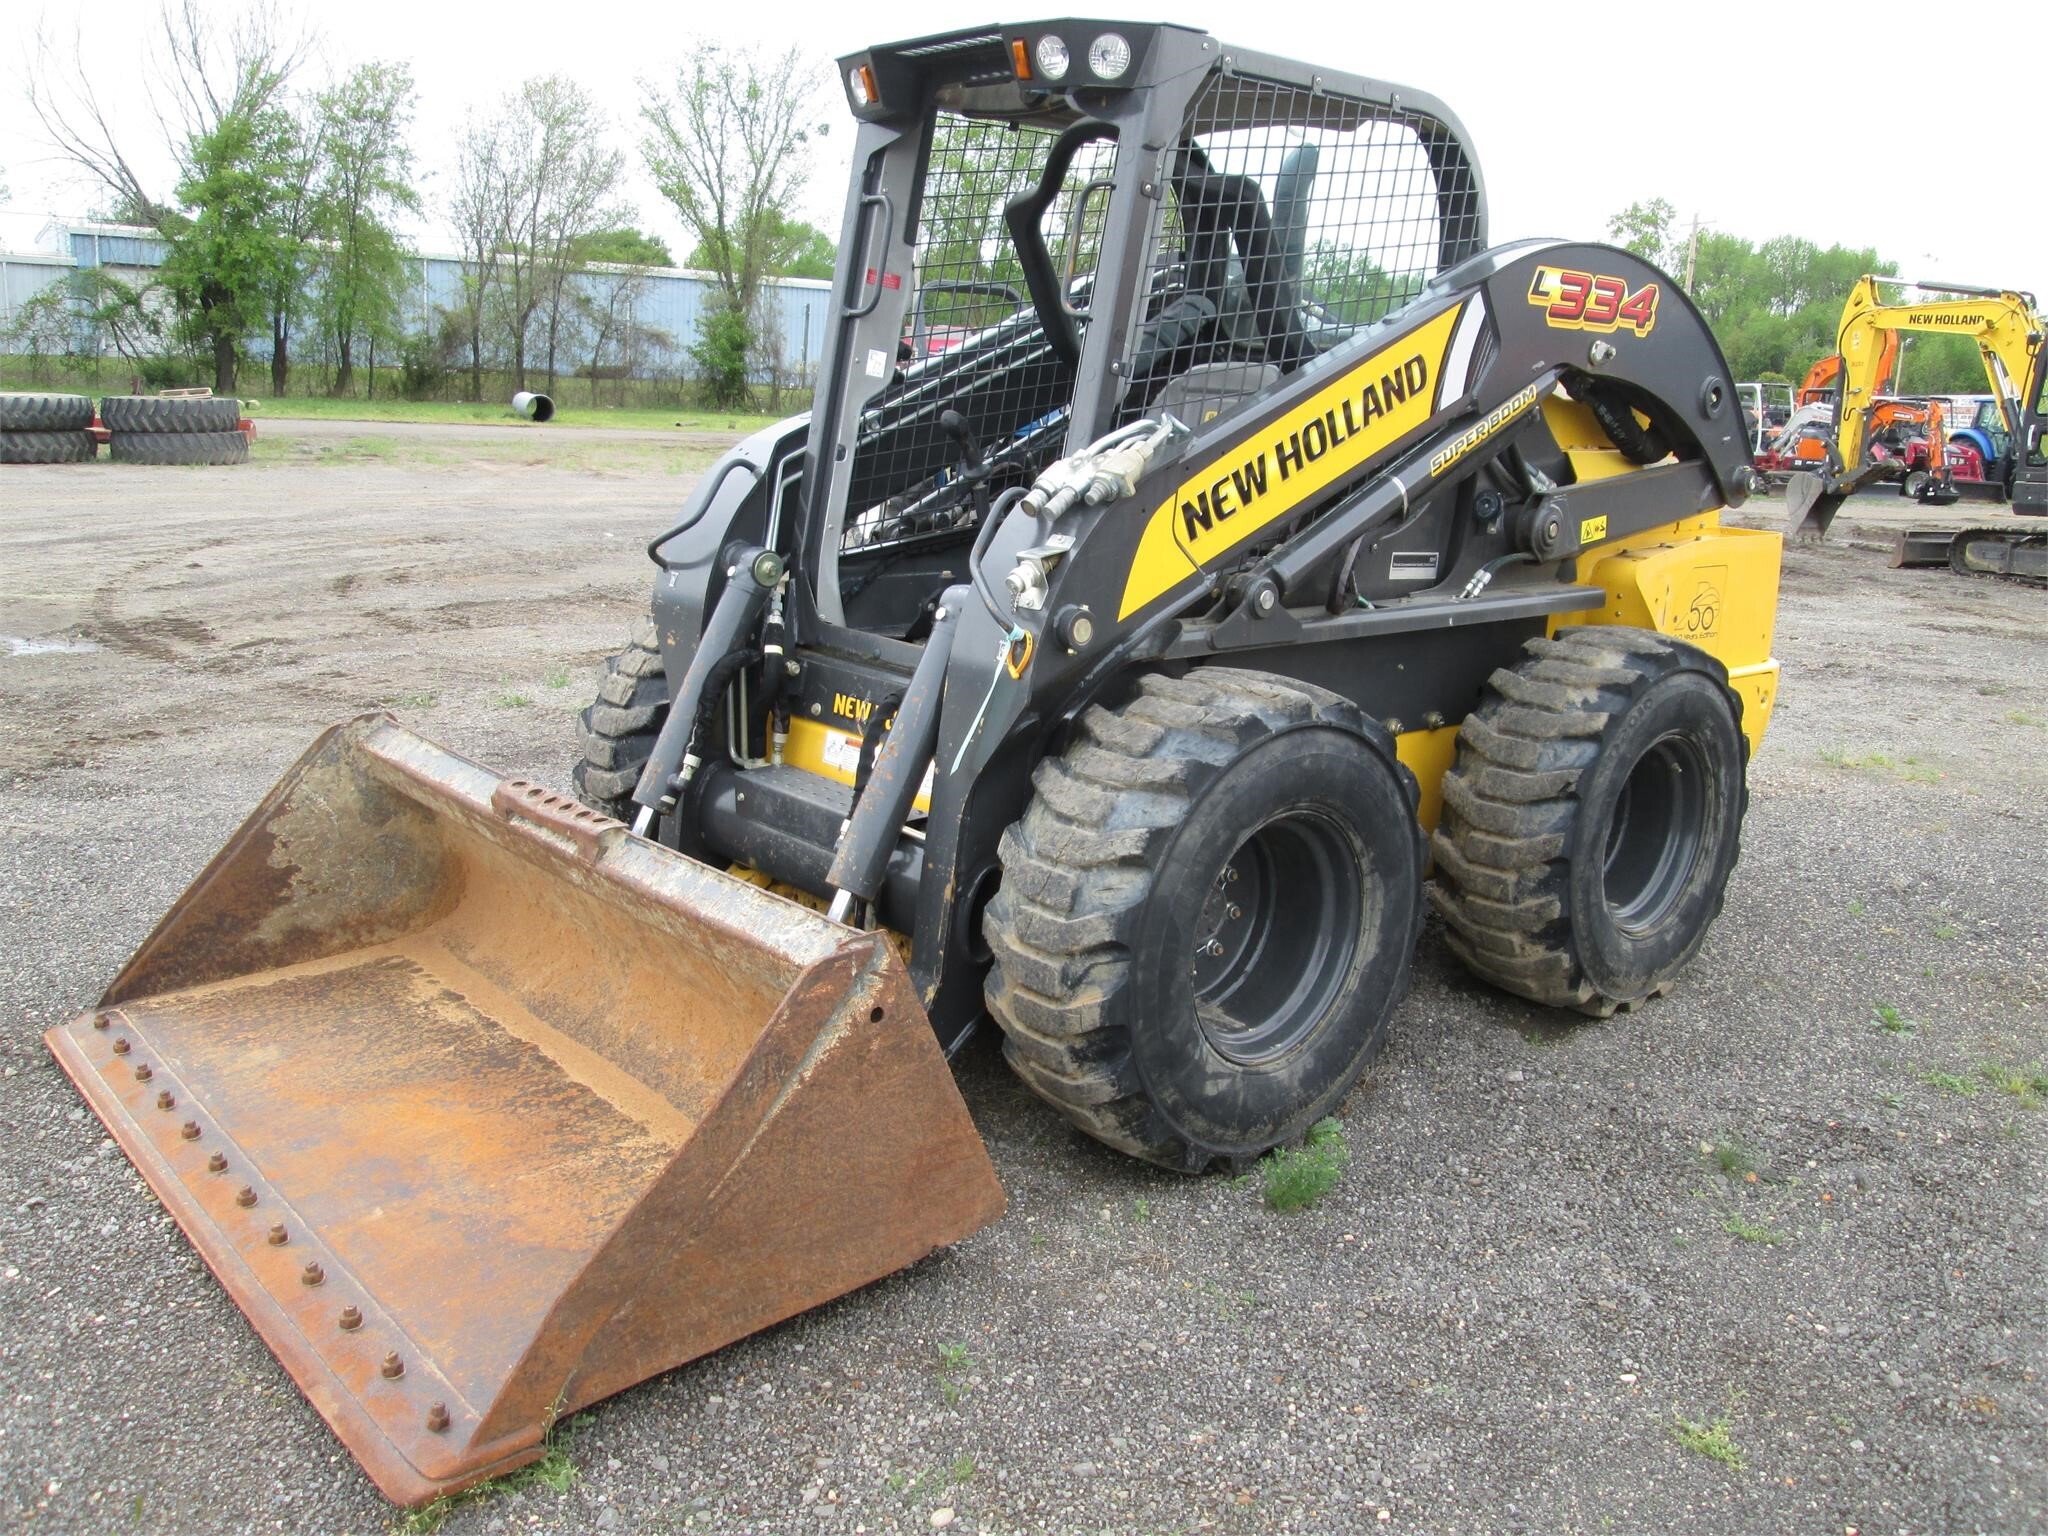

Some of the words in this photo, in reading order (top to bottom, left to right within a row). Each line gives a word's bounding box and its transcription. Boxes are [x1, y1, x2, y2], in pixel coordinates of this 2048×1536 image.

[1528, 266, 1660, 338] L334
[1908, 314, 1932, 324] NEW
[1180, 453, 1268, 542] NEW
[1275, 354, 1428, 481] HOLLAND
[1430, 421, 1489, 479] SUPER
[1488, 384, 1537, 434] BOOM
[1687, 594, 1714, 631] 50
[833, 693, 872, 721] NEW
